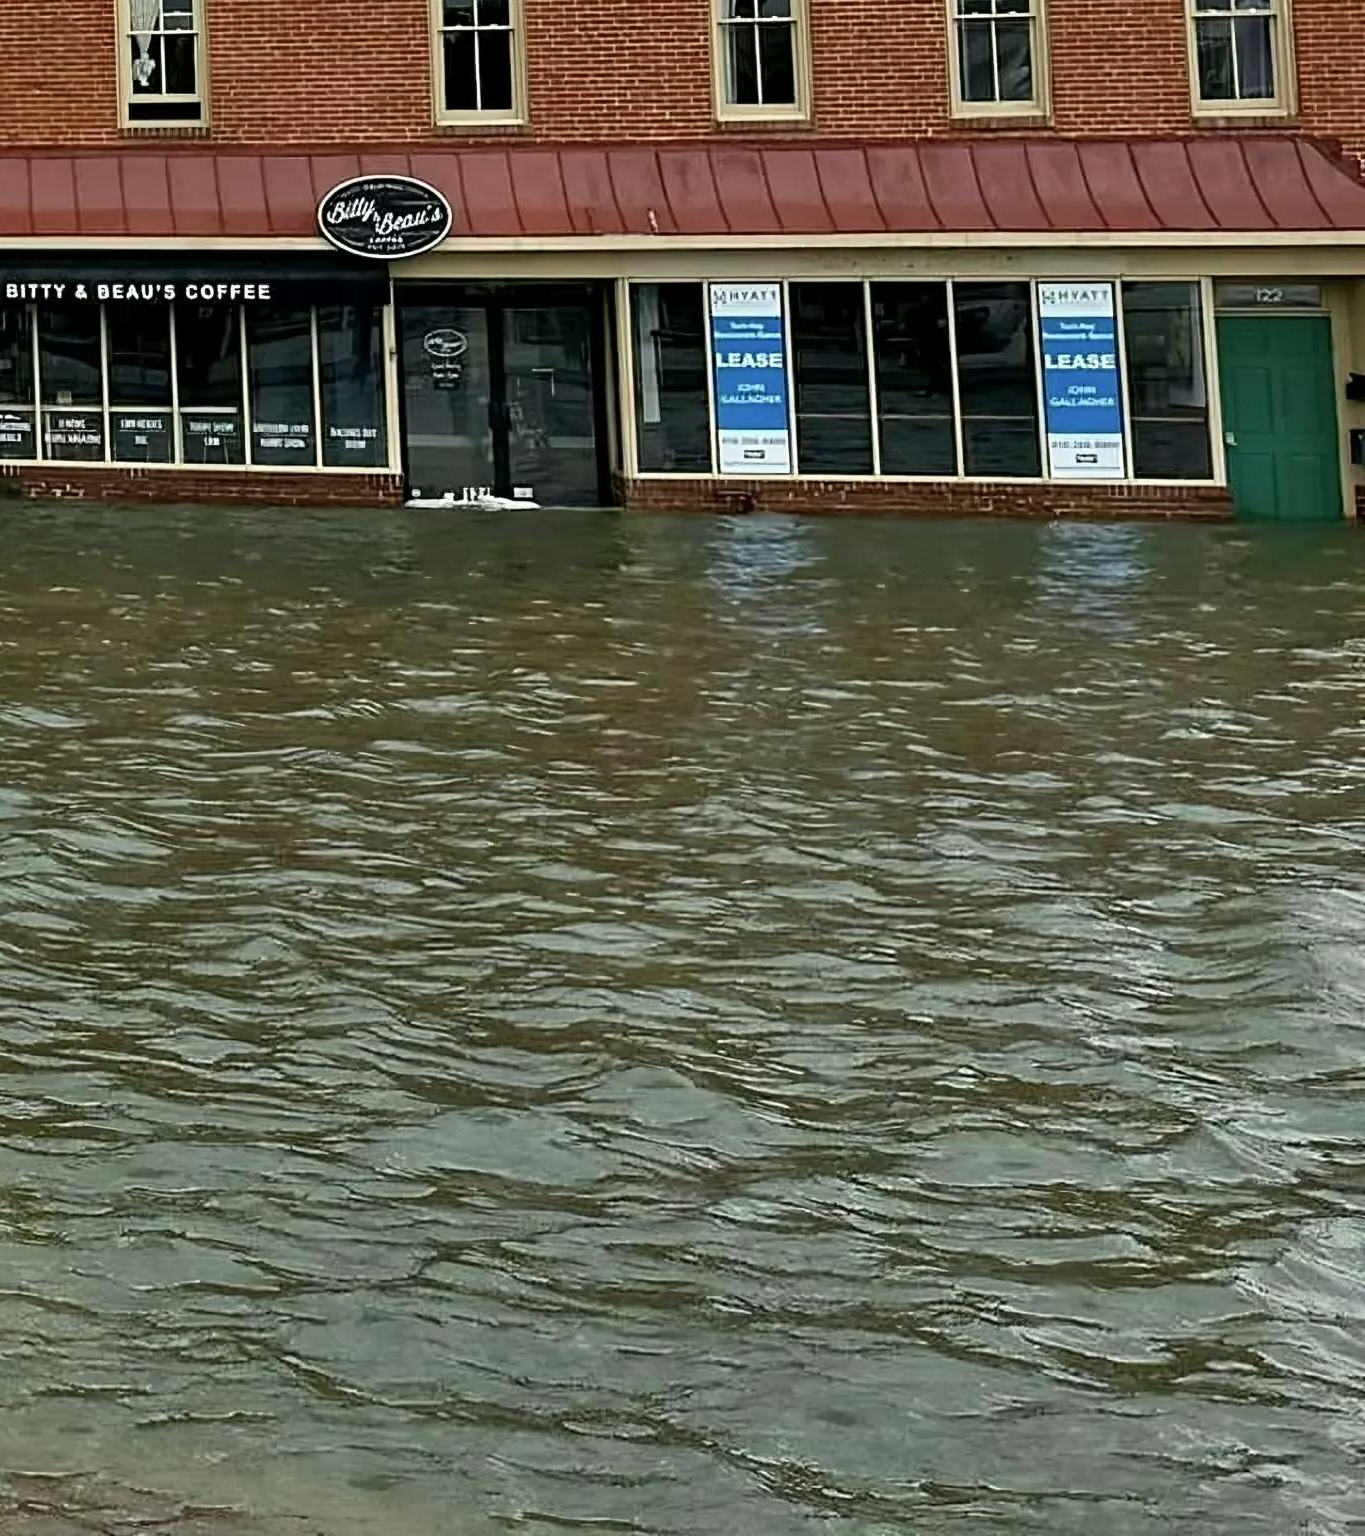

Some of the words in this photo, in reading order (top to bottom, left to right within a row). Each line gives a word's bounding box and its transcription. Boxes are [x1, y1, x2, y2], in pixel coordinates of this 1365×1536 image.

[6, 283, 66, 299] BITTY
[74, 284, 88, 300] &
[97, 284, 176, 300] BEAU'S
[186, 284, 270, 300] COFFEE
[729, 290, 777, 302] HYATT
[1058, 290, 1109, 302] HYATT
[715, 352, 783, 369] LEASE
[1044, 353, 1116, 370] LEASE
